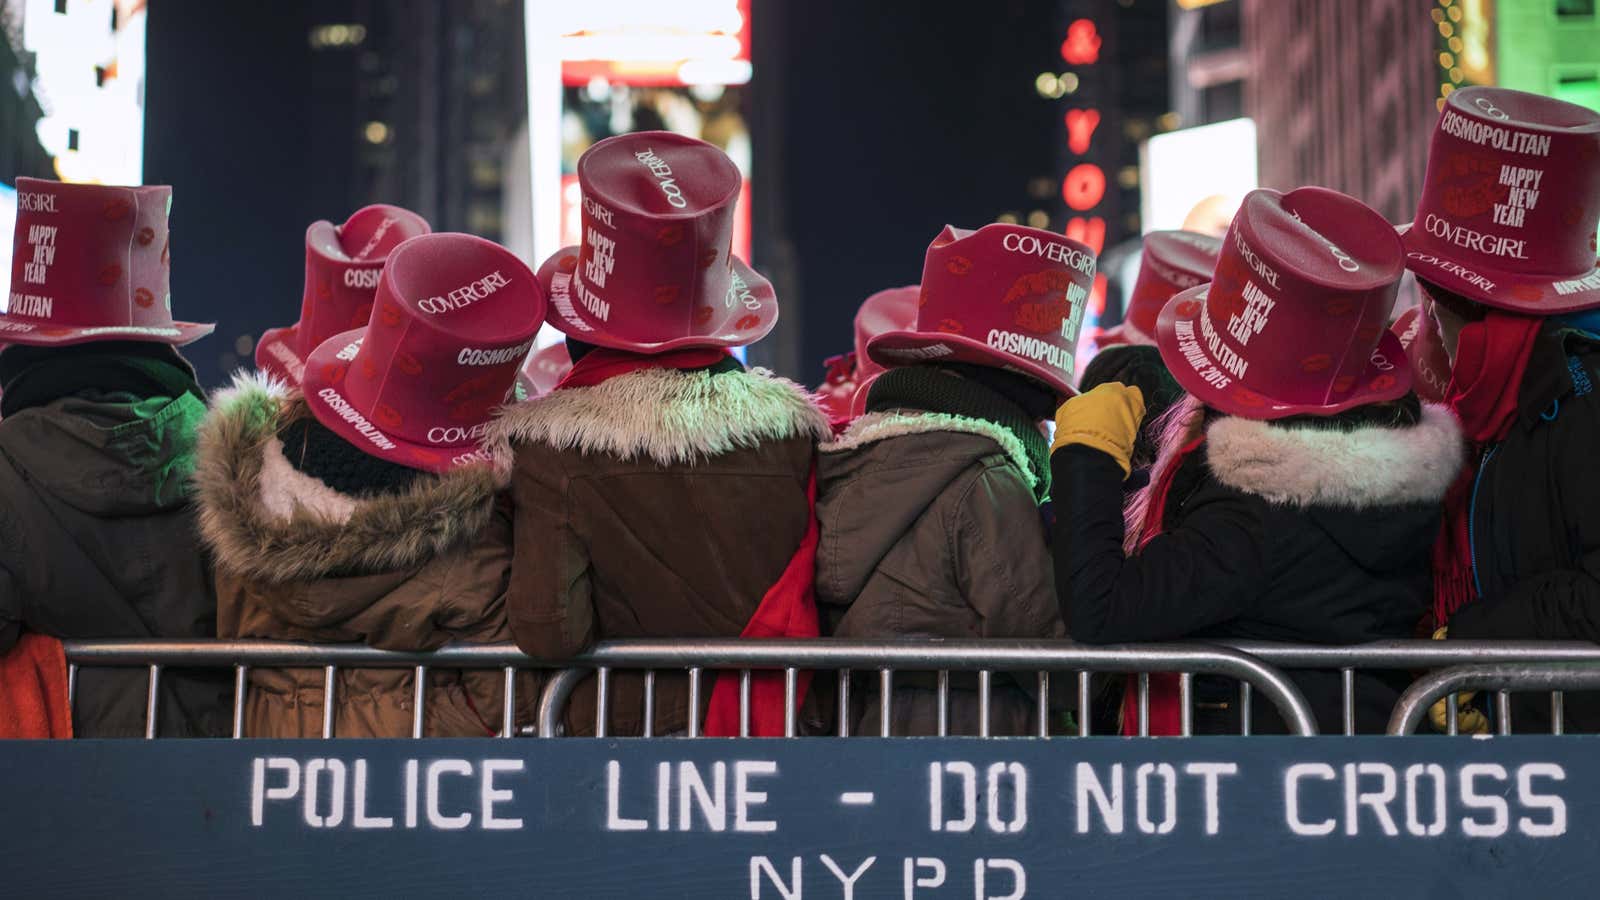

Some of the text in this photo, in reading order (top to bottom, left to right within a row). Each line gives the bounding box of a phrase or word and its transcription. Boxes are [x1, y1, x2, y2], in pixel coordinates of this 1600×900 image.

[1441, 110, 1551, 156] COSMOPOLITAN
[635, 147, 686, 208] COVERGIRL
[1498, 165, 1543, 190] HAPPY
[1508, 187, 1540, 210] NEW
[1493, 203, 1525, 227] YEAR
[28, 224, 57, 246] HAPPY
[587, 226, 615, 257] HAPPY
[1425, 214, 1528, 259] COVERGIRL
[33, 245, 55, 265] NEW
[594, 250, 614, 275] NEW
[24, 263, 46, 284] YEAR
[586, 258, 606, 288] YEAR
[1407, 252, 1496, 294] COVERGIRL
[418, 270, 512, 314] COVERGIRL
[1242, 280, 1277, 317] HAPPY
[1175, 320, 1195, 341] TIMES
[1227, 312, 1251, 346] YEAR
[1241, 303, 1268, 335] NEW
[1178, 341, 1212, 371] SQUARE
[1199, 366, 1232, 389] 2015
[318, 388, 396, 450] COSMOPOLITAN
[252, 758, 1567, 837] POLICE LINE - DO NOT CROSS
[750, 855, 1026, 900] NYPD
